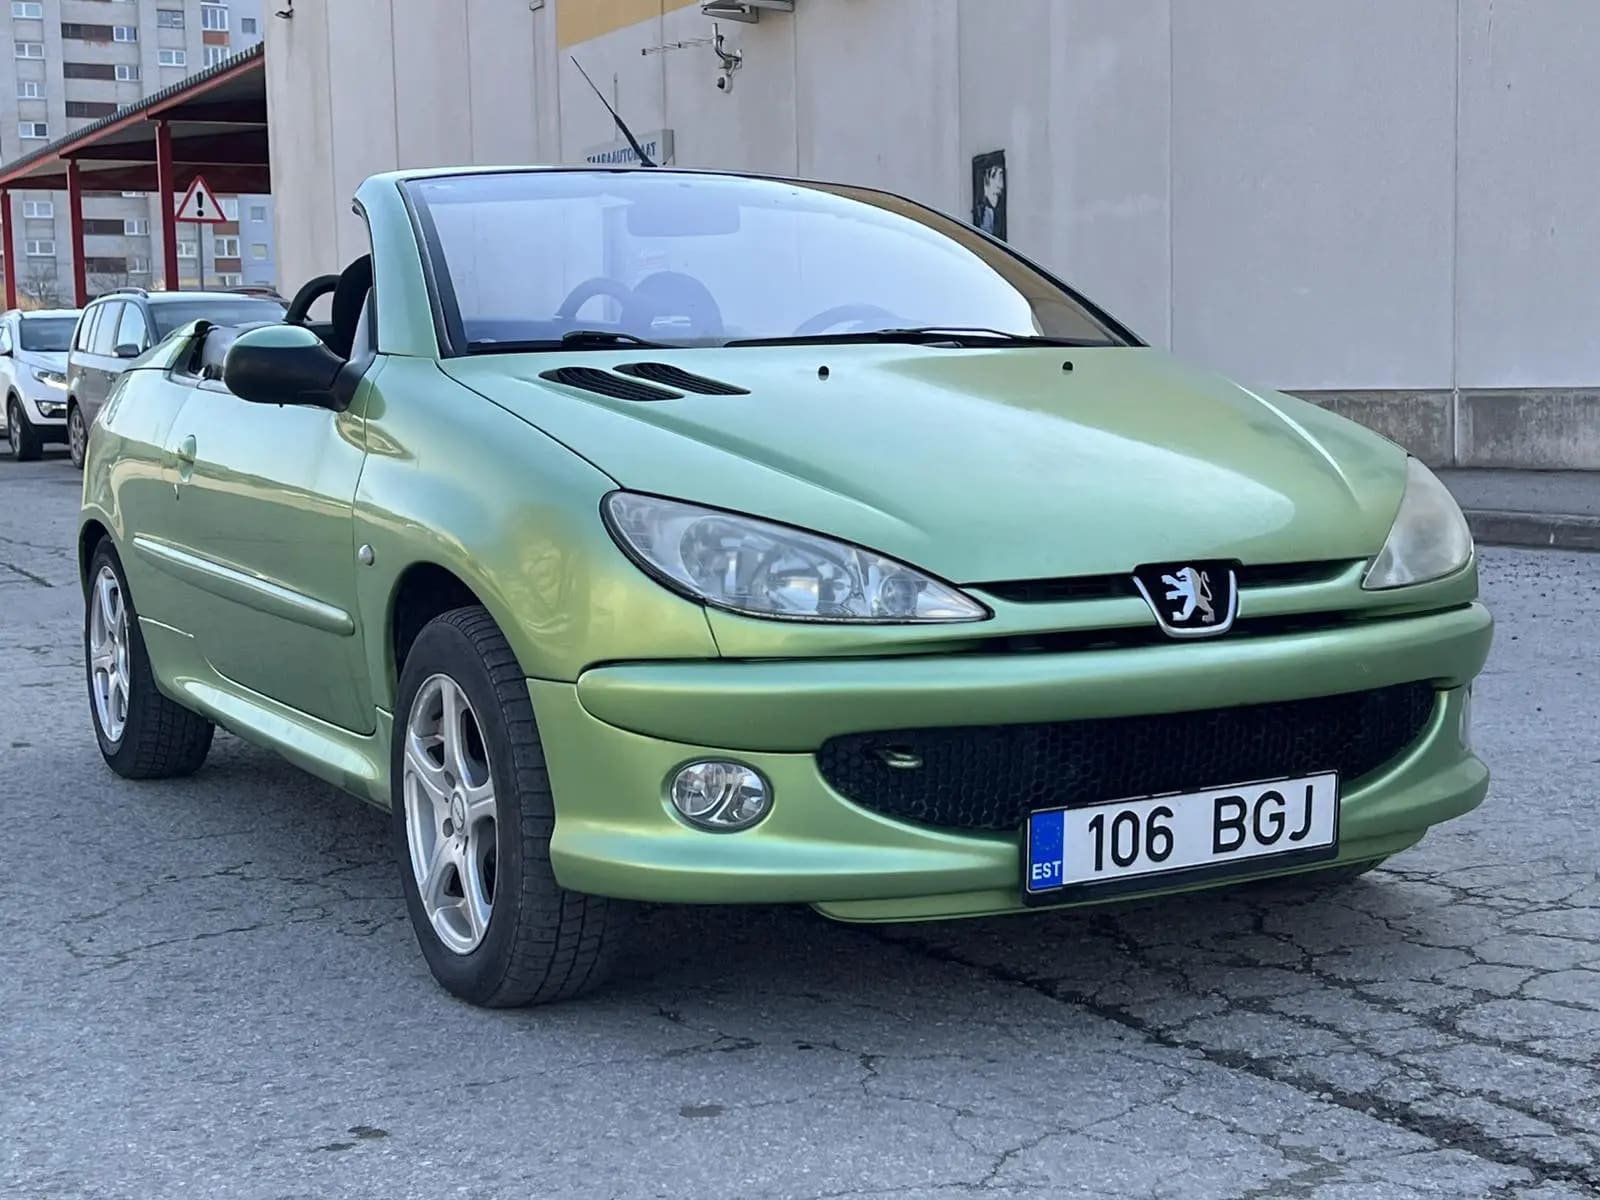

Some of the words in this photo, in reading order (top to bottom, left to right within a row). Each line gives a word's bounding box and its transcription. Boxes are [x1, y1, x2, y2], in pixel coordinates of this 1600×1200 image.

[1088, 806, 1174, 872] 106
[1212, 784, 1314, 855] BGJ
[1031, 860, 1062, 881] EST
